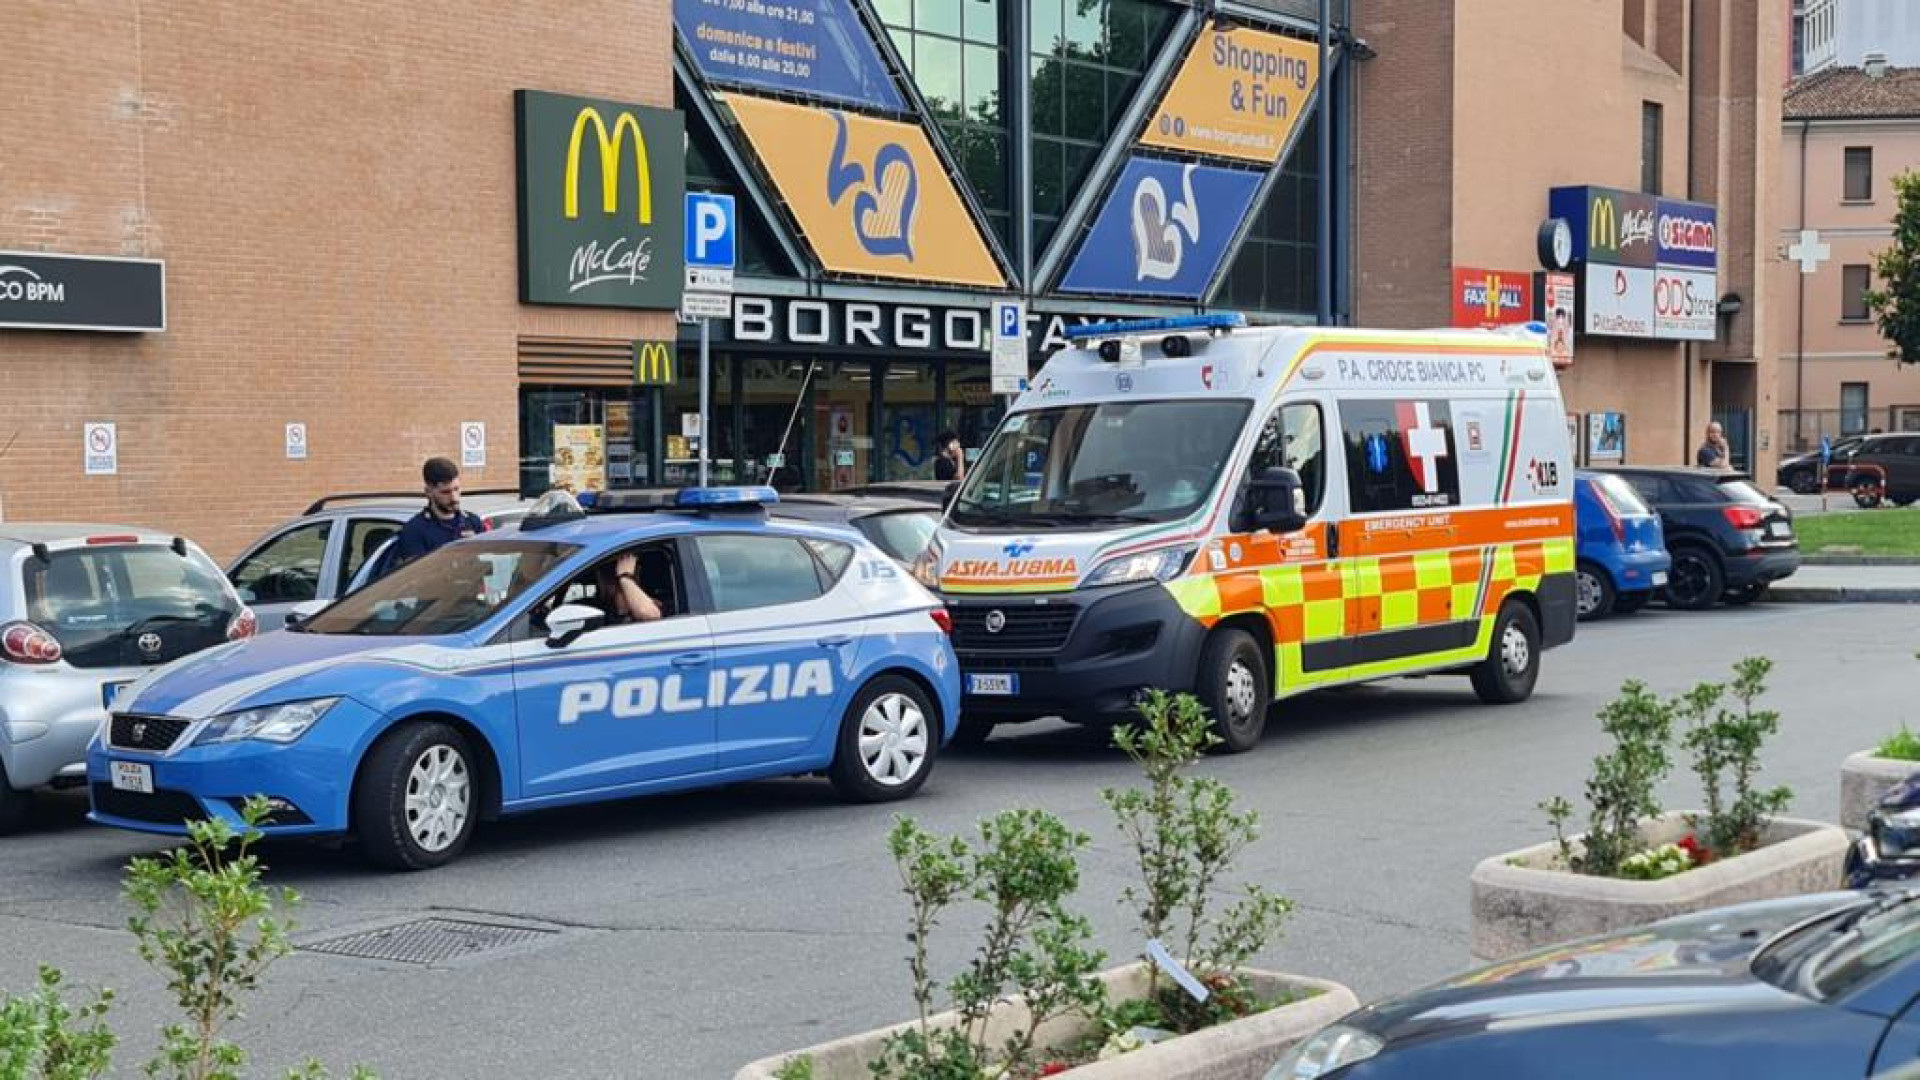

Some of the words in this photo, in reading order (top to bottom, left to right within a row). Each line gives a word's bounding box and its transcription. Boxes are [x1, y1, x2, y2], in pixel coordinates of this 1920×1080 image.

[697, 24, 762, 49] domenica
[777, 38, 817, 60] festivi
[1213, 35, 1308, 90] Shopping
[1231, 80, 1245, 111] &
[1252, 84, 1288, 119] Fun
[696, 202, 726, 258] P
[569, 237, 652, 286] McCafé
[27, 282, 65, 302] BPM
[734, 298, 981, 349] BORGO
[1004, 308, 1016, 334] P
[1338, 359, 1365, 381] P.A.
[1367, 360, 1415, 382] CROCE
[1417, 361, 1467, 384] BIANCA
[1469, 363, 1486, 383] PC
[1364, 517, 1426, 531] EMERGENCY
[1428, 515, 1450, 527] UNIT
[558, 659, 834, 724] POLIZIA
